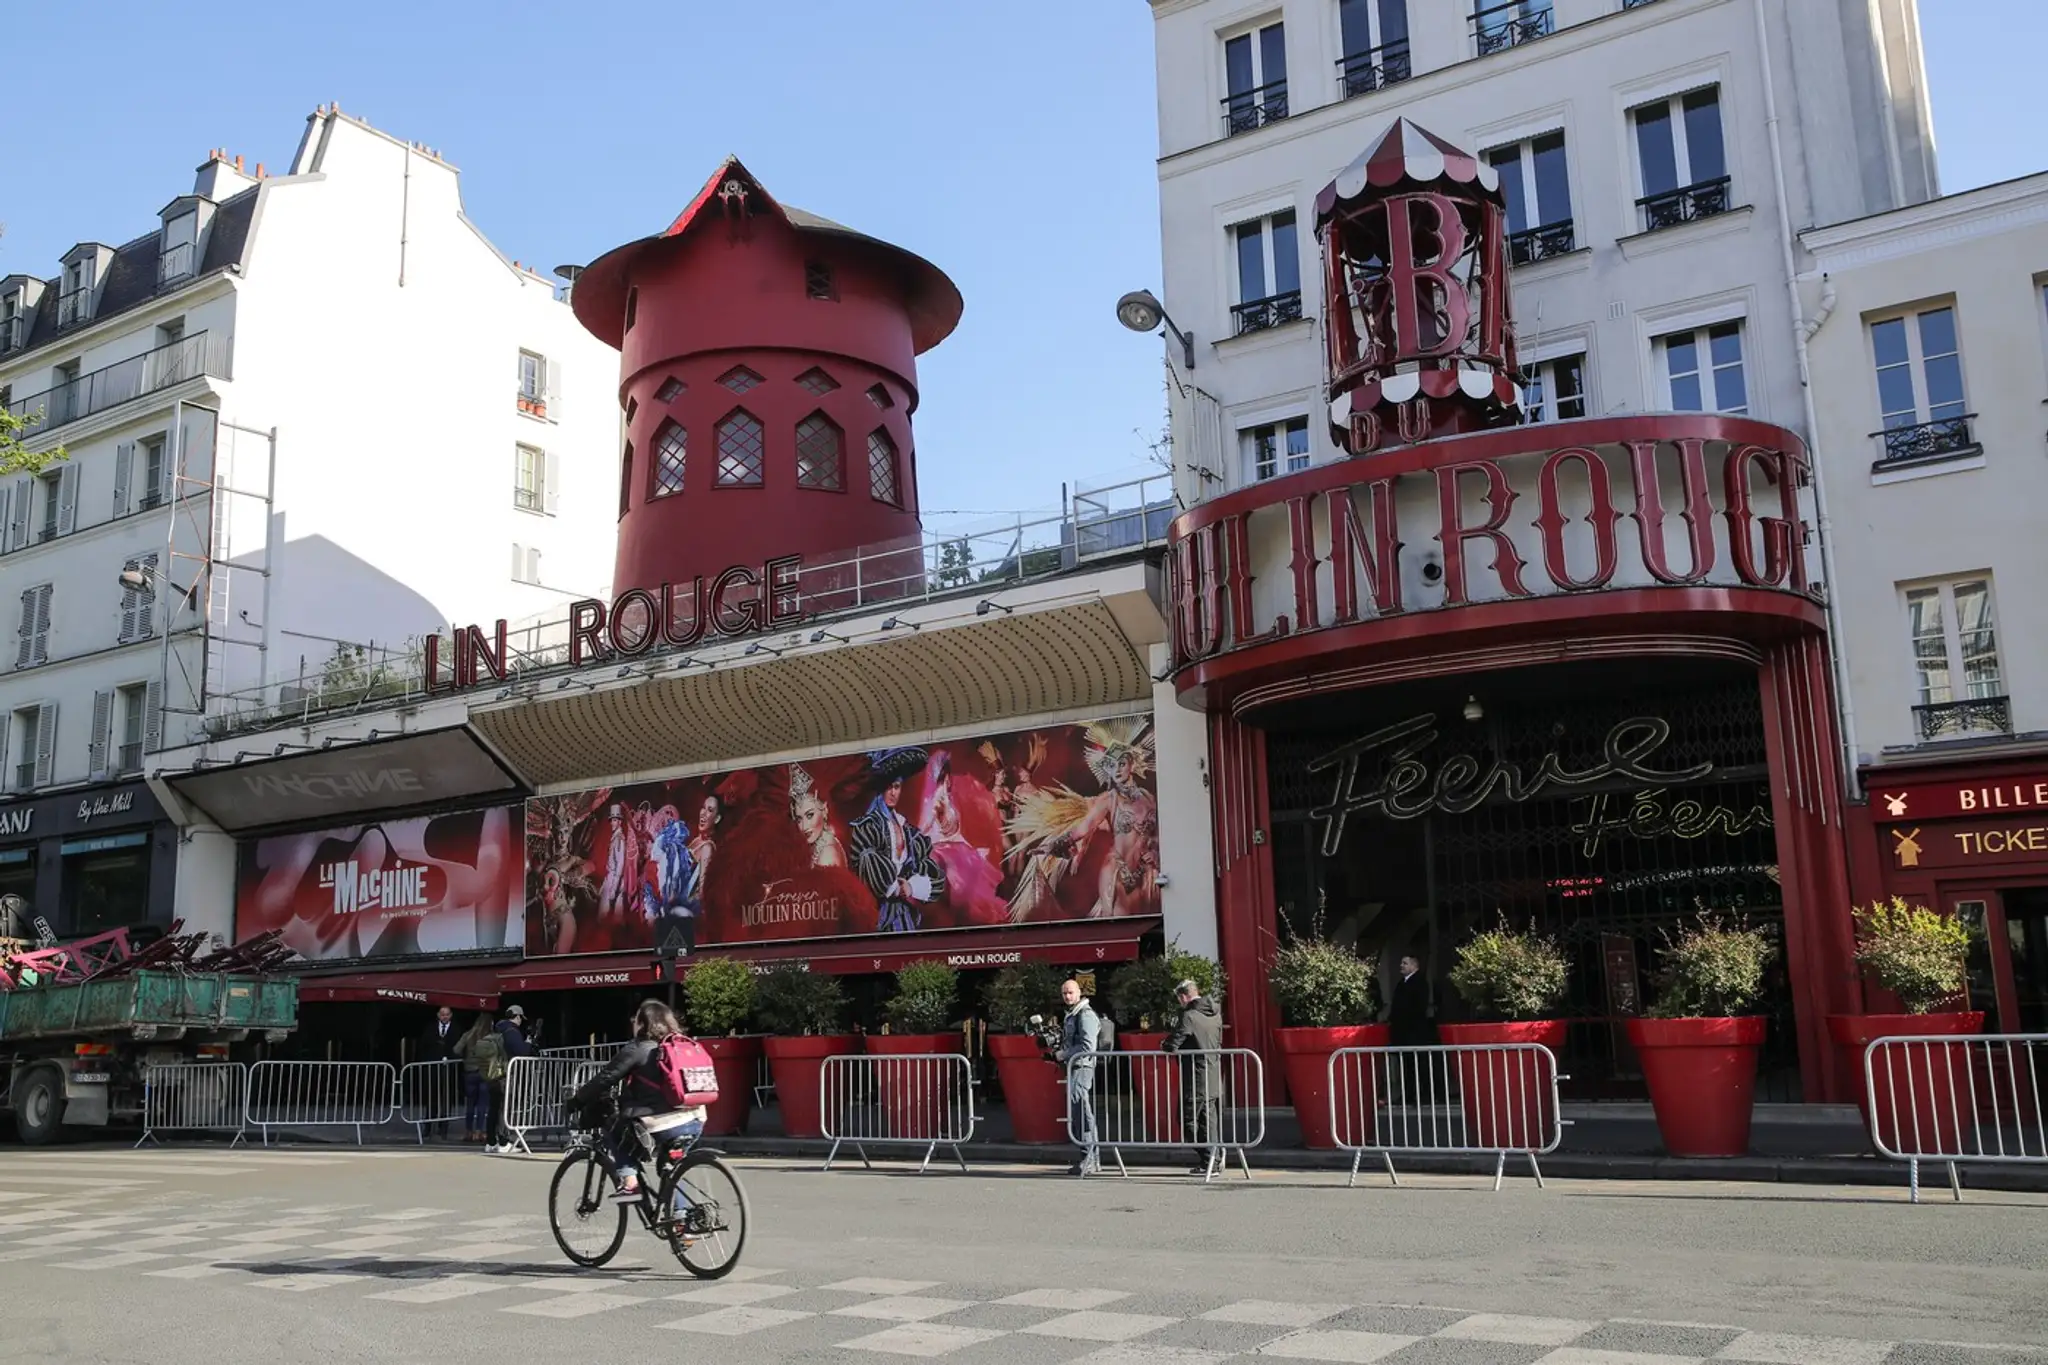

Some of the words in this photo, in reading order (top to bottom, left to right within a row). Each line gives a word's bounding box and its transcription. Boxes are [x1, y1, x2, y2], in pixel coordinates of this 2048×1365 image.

[1350, 397, 1432, 453] DU
[1433, 438, 1827, 606] ROUGE
[425, 618, 507, 695] LIN
[569, 554, 807, 669] ROUGE
[77, 799, 92, 823] By
[93, 797, 109, 816] the
[109, 792, 133, 812] Mill
[1959, 783, 2048, 810] BILLE
[1954, 827, 2048, 854] TICKE
[319, 863, 334, 888] LA
[755, 878, 819, 903] Forever
[741, 903, 790, 928] MOULIN
[792, 897, 840, 921] ROUGE
[948, 952, 985, 966] MOULIN
[987, 951, 1021, 963] ROUGE
[574, 974, 603, 985] MOULIN
[604, 973, 630, 983] ROUGE
